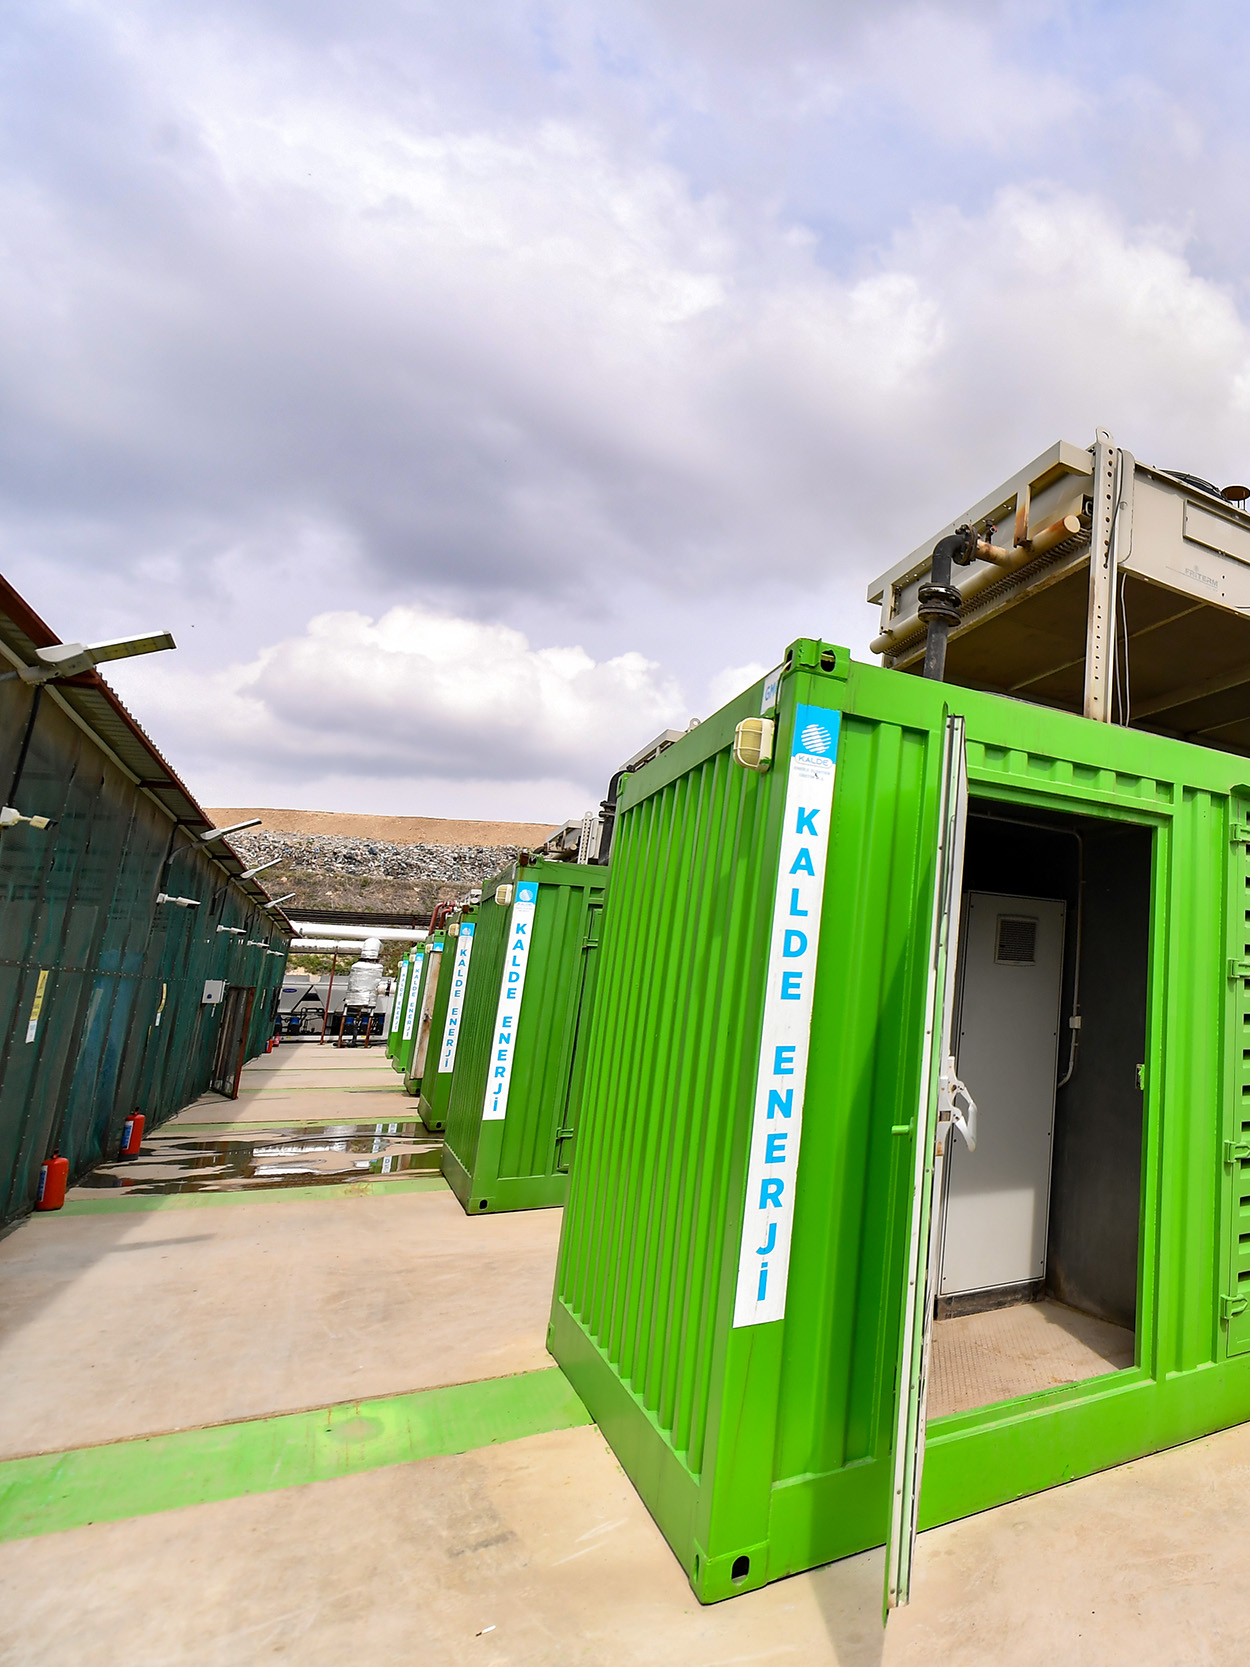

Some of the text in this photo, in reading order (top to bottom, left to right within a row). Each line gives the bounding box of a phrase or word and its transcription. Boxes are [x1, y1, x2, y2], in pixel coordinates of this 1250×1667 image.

[798, 755, 829, 766] KALDE
[781, 806, 820, 1001] KALDE
[454, 949, 467, 998] KALDE
[506, 923, 528, 1000] KALDE
